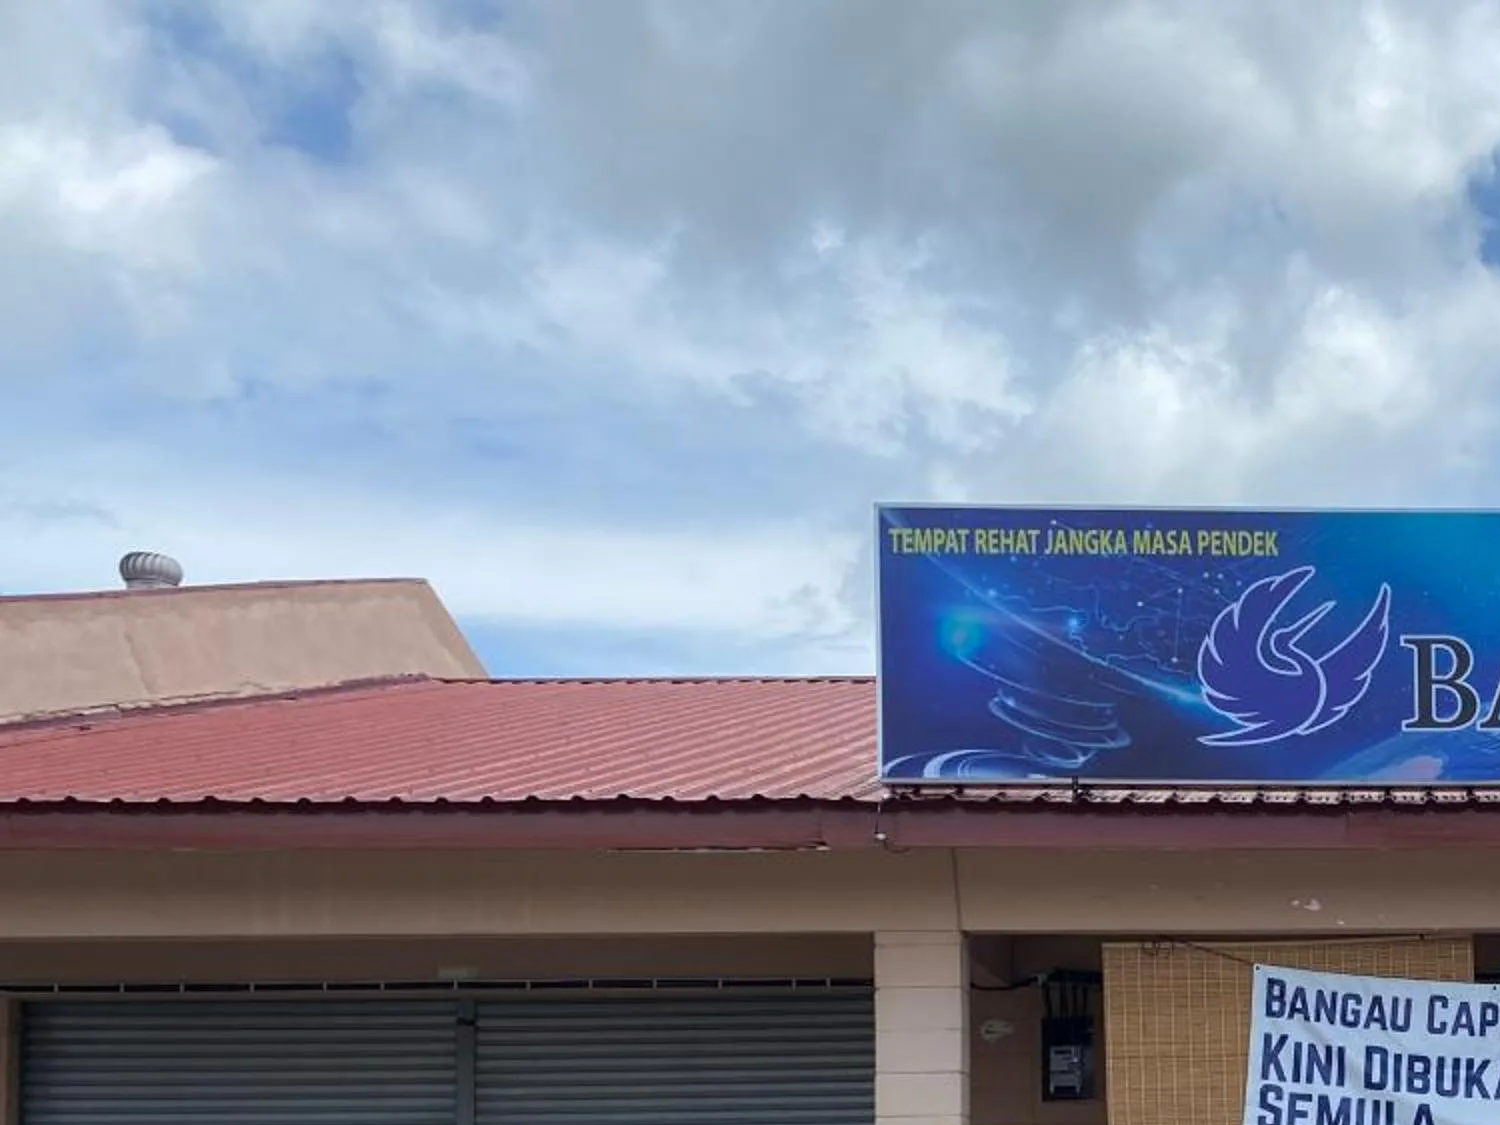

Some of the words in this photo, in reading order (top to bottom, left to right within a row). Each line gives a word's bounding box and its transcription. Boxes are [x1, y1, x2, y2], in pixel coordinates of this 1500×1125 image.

[888, 527, 969, 555] TEMPAT
[974, 528, 1040, 555] REHAT
[1044, 529, 1127, 557] JANGKA
[1132, 530, 1193, 556] MASA
[1198, 530, 1279, 557] PENDEK
[1265, 977, 1413, 1033] BANGAU
[1260, 1032, 1345, 1088] KINI
